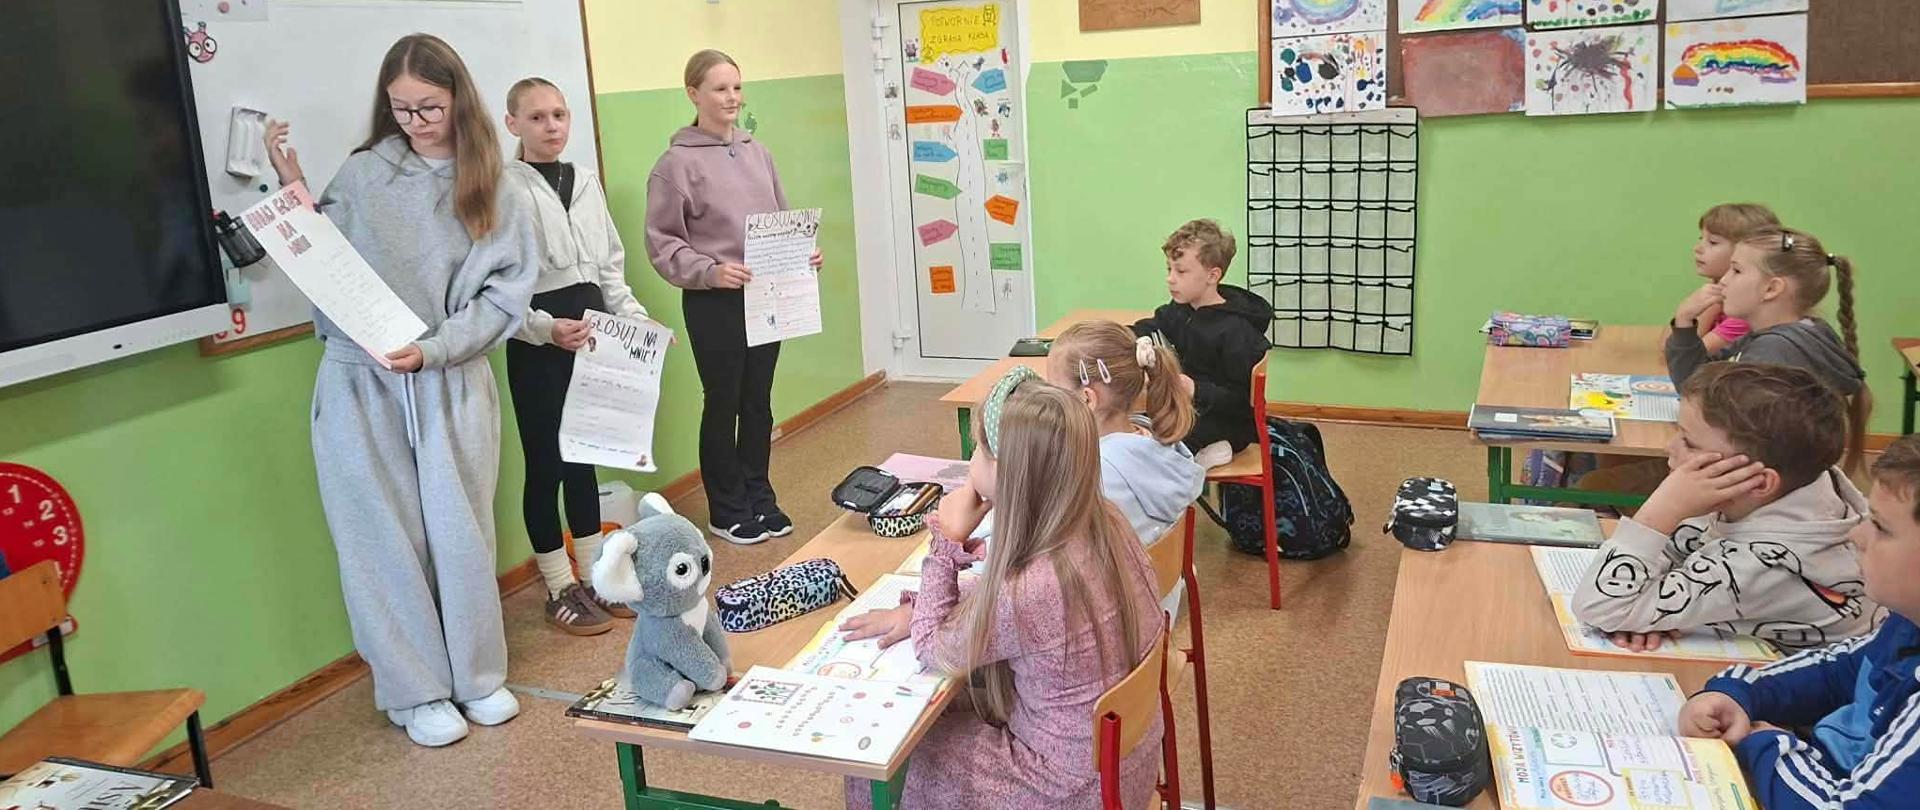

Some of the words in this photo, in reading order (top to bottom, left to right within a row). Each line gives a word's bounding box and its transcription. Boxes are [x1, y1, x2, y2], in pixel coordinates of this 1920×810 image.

[588, 314, 638, 349] GŁOSUJ
[643, 329, 658, 348] NA
[7, 484, 21, 504] 1
[39, 499, 56, 521] 2
[52, 525, 68, 546] 3
